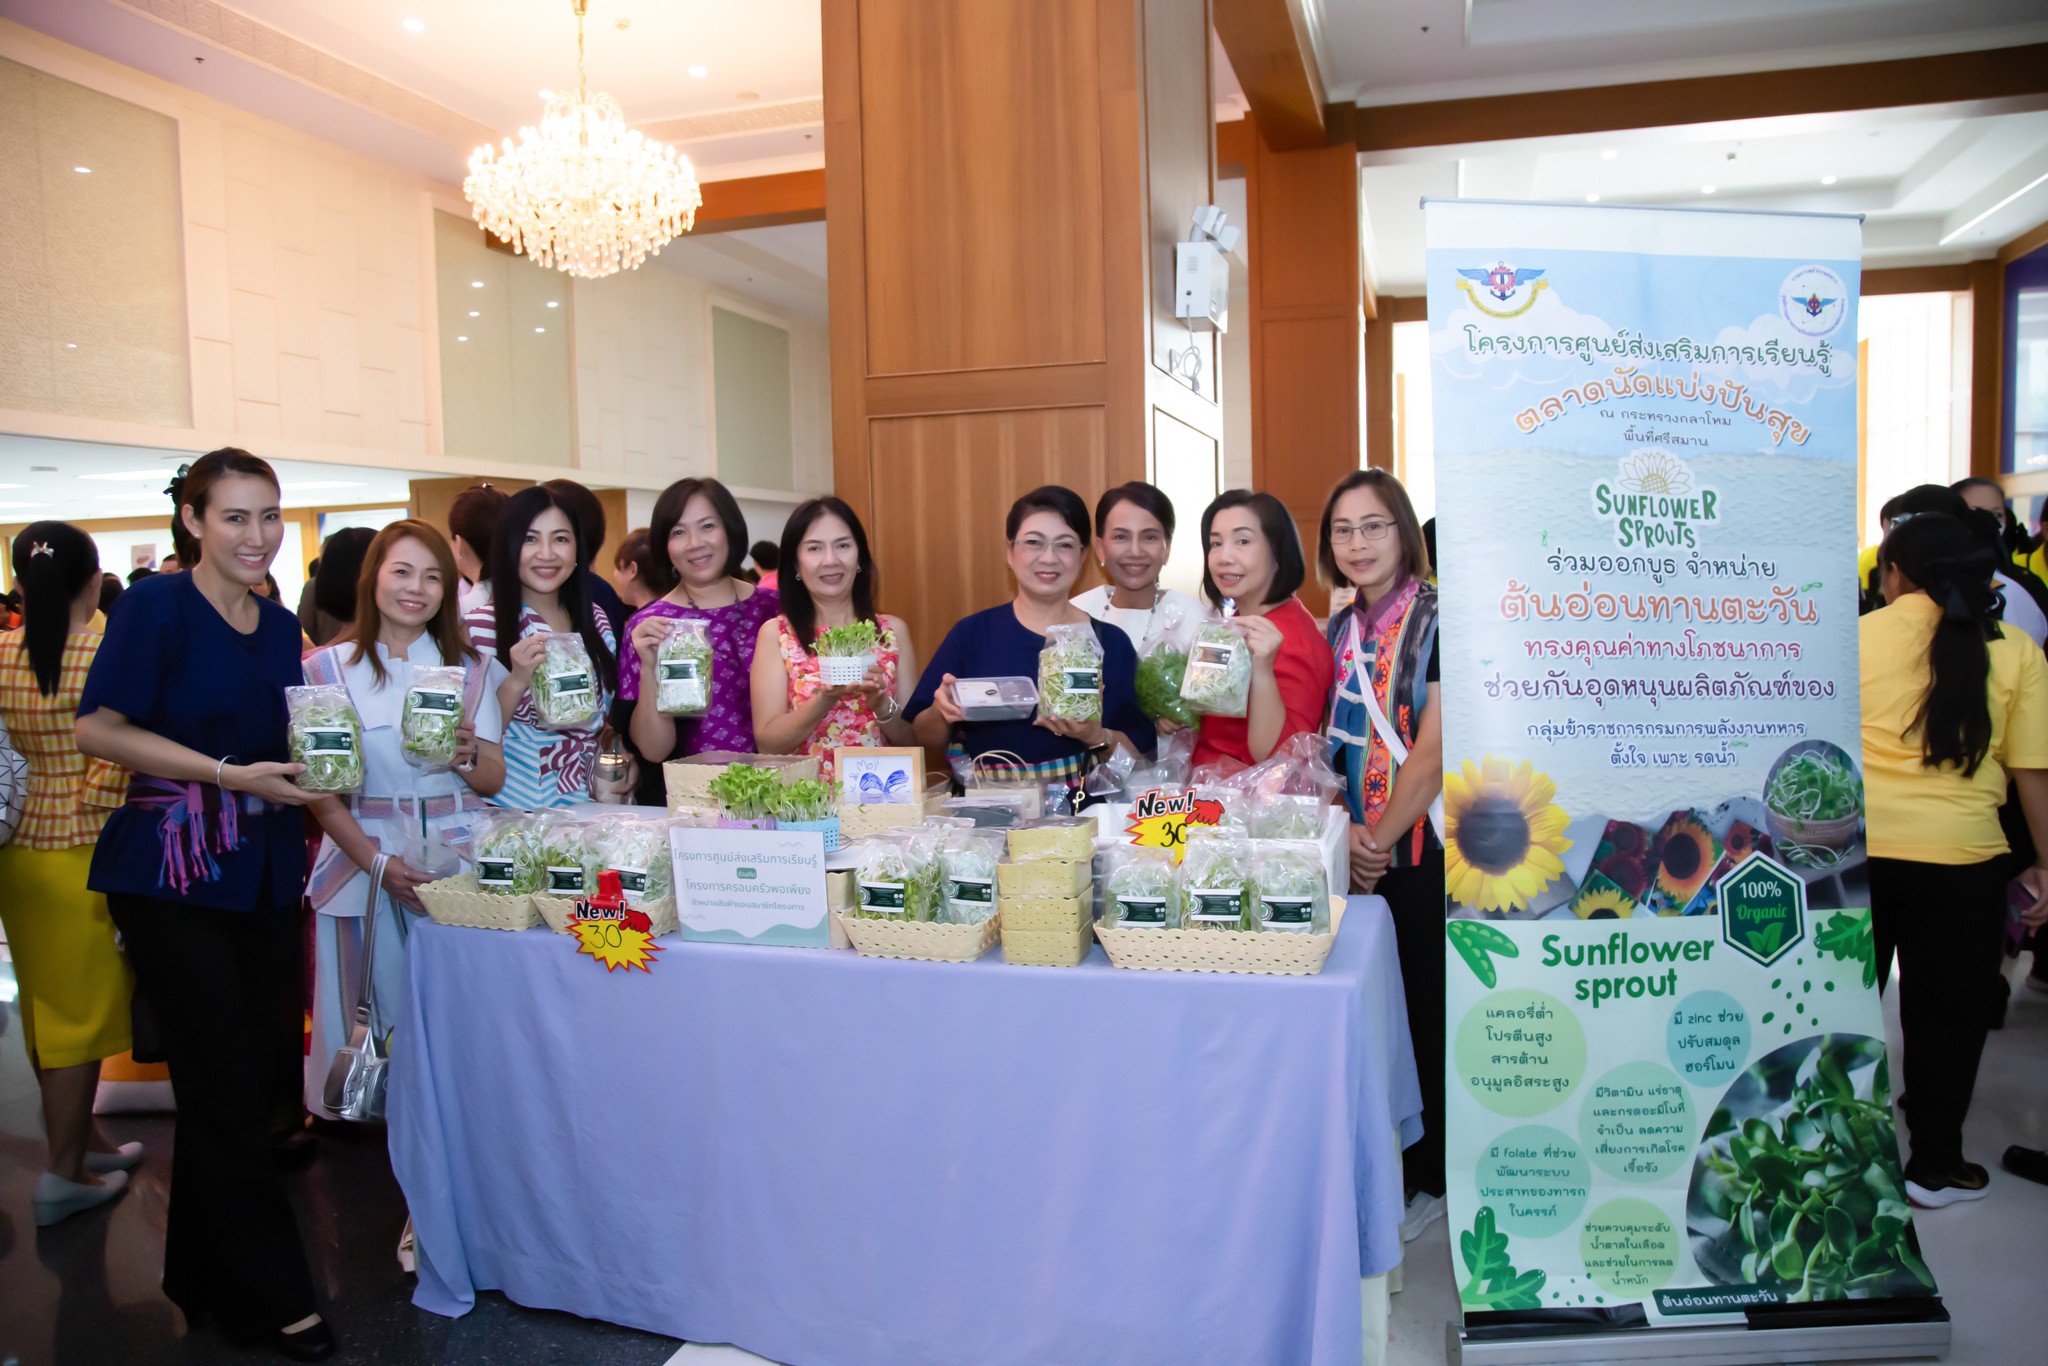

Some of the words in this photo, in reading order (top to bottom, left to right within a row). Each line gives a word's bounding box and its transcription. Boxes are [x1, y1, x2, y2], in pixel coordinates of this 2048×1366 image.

[1463, 324, 1831, 376] โครงการศูนย์ส่งเสริมการเรียนรู้
[1515, 365, 1811, 444] ตลาดนัดแบ่งปันสุข
[1600, 409, 1614, 418] ณ
[1621, 410, 1732, 426] กระทรวงกลาโหม
[1623, 424, 1708, 446] พื้นที่ศรีสมาน
[1596, 483, 1717, 520] SUNFLOWER
[1618, 516, 1696, 549] SPROUTS
[1547, 547, 1676, 584] ร่วมออกบูธ
[1685, 551, 1776, 577] จำหน่าย
[1500, 579, 1818, 623] ต้นอ่อนทานตะวัน
[1524, 629, 1801, 666] ทรงคุณค่าทางโภชนาการ
[1484, 669, 1835, 707] ช่วยกันอุดหนุนผลิตภัณฑ์ของ
[1527, 718, 1806, 742] กลุ่มข้าราชการกรมการพลังงานทหาร
[1610, 740, 1646, 766] ตั้งใจ
[1652, 751, 1688, 766] เพาะ
[1694, 740, 1737, 766] รดน้ำ
[1138, 791, 1194, 818] New!
[1160, 821, 1188, 848] 30
[1739, 881, 1782, 899] 100%
[576, 899, 625, 920] New!
[1736, 903, 1788, 924] Organic
[588, 924, 622, 949] 30
[1541, 932, 1715, 967] Sunflower
[1575, 968, 1677, 1009] sprout
[1486, 1001, 1553, 1019] แคลอรี่ต่ำ
[1674, 1011, 1683, 1025] มี
[1688, 1012, 1712, 1024] zinc
[1718, 1009, 1744, 1022] ช่วย
[1485, 1025, 1552, 1047] โปรตีนสูง
[1678, 1034, 1741, 1051] ปรับสมดุล
[1491, 1051, 1549, 1065] สารต้าน
[1685, 1055, 1735, 1073] ฮอร์โมน
[1471, 1075, 1570, 1092] อนุมูลอิสระสูง
[1595, 1086, 1643, 1098] มีวิตามิน
[1597, 1123, 1634, 1135] จำเป็น
[1639, 1125, 1683, 1135] ลดความ
[1490, 1147, 1499, 1158] มี
[1504, 1147, 1538, 1158] folate
[1543, 1143, 1576, 1158] ที่ช่วย
[1595, 1139, 1685, 1154] เสี่ยงการเกิดโรค
[1496, 1165, 1570, 1177] พัฒนาระบบ
[1480, 1187, 1586, 1197] ประสาทของทารก
[1509, 1203, 1557, 1217] ในครรภ์
[1585, 1222, 1670, 1236] ช่วยควบคุมระดับ
[1662, 1289, 1779, 1308] ต้นอ่อนทานตะวัน
